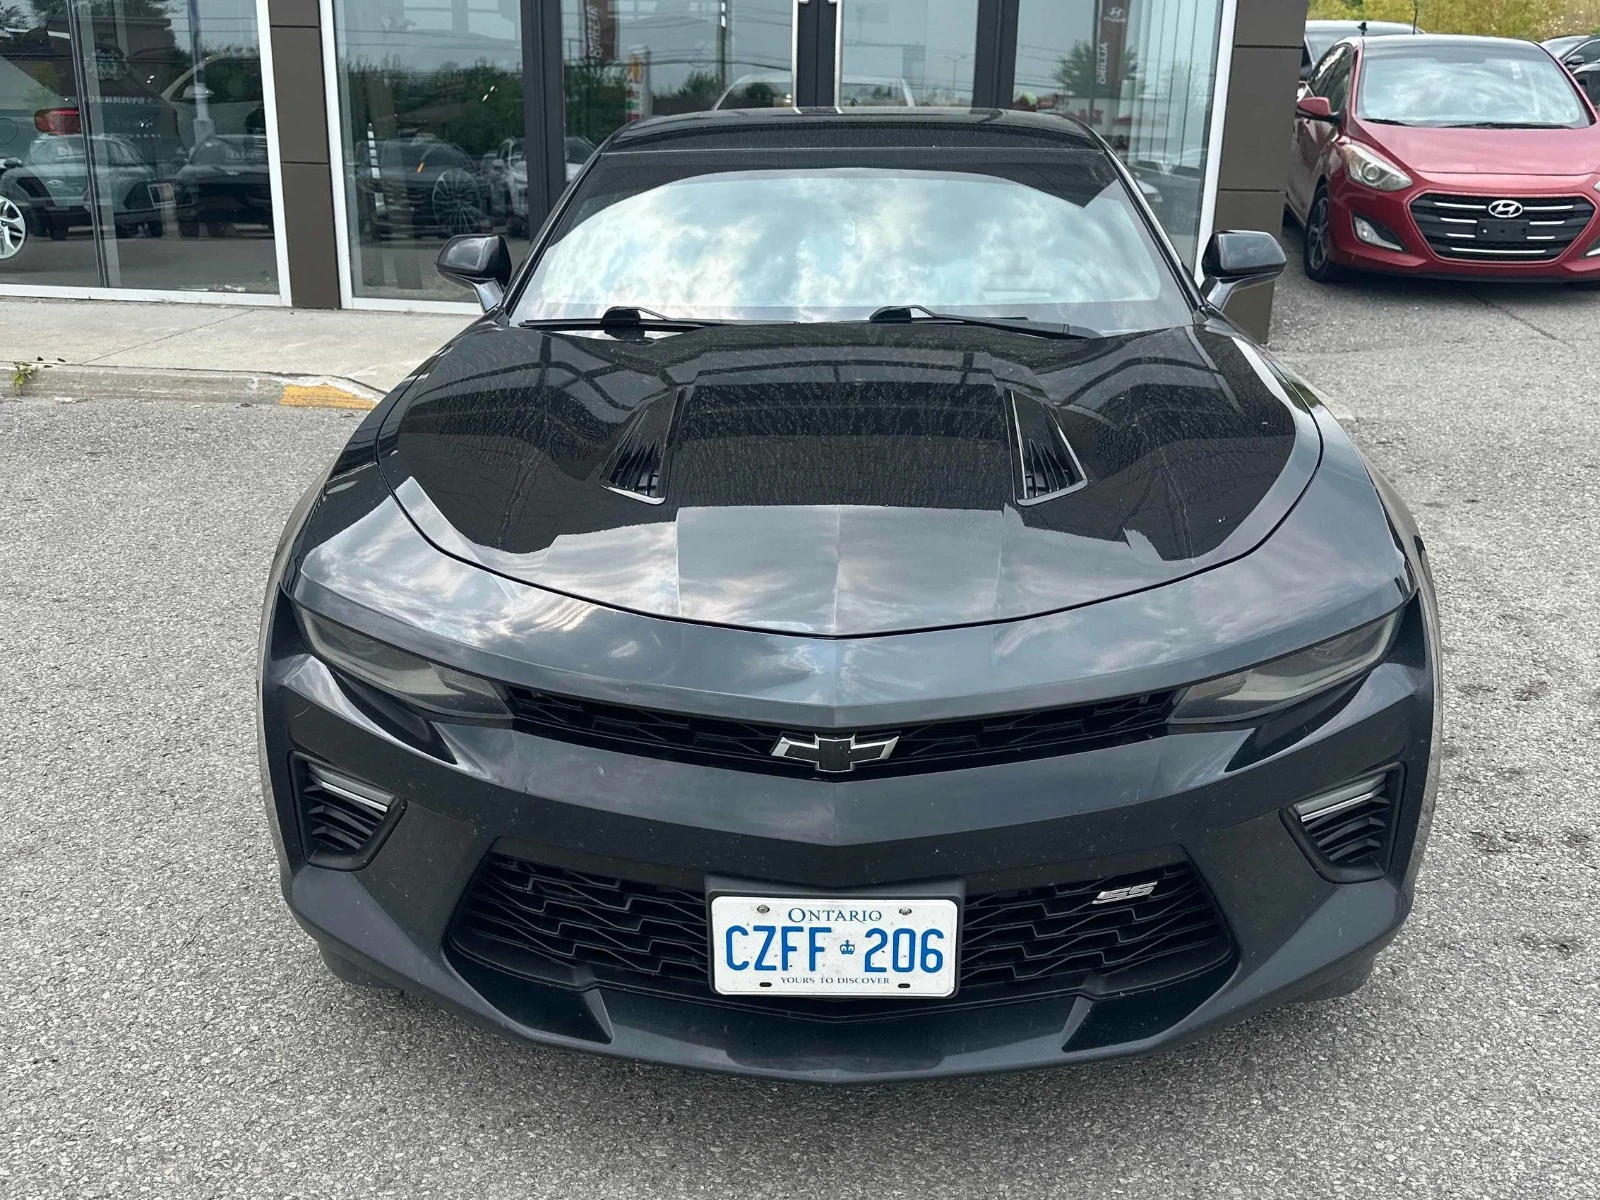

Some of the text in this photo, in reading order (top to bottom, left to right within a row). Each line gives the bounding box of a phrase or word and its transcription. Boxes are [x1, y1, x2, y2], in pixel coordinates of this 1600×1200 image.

[1091, 880, 1158, 905] SS
[725, 925, 944, 973] CZFF 206
[780, 976, 815, 984] YOURS
[837, 977, 890, 985] DISCOVER
